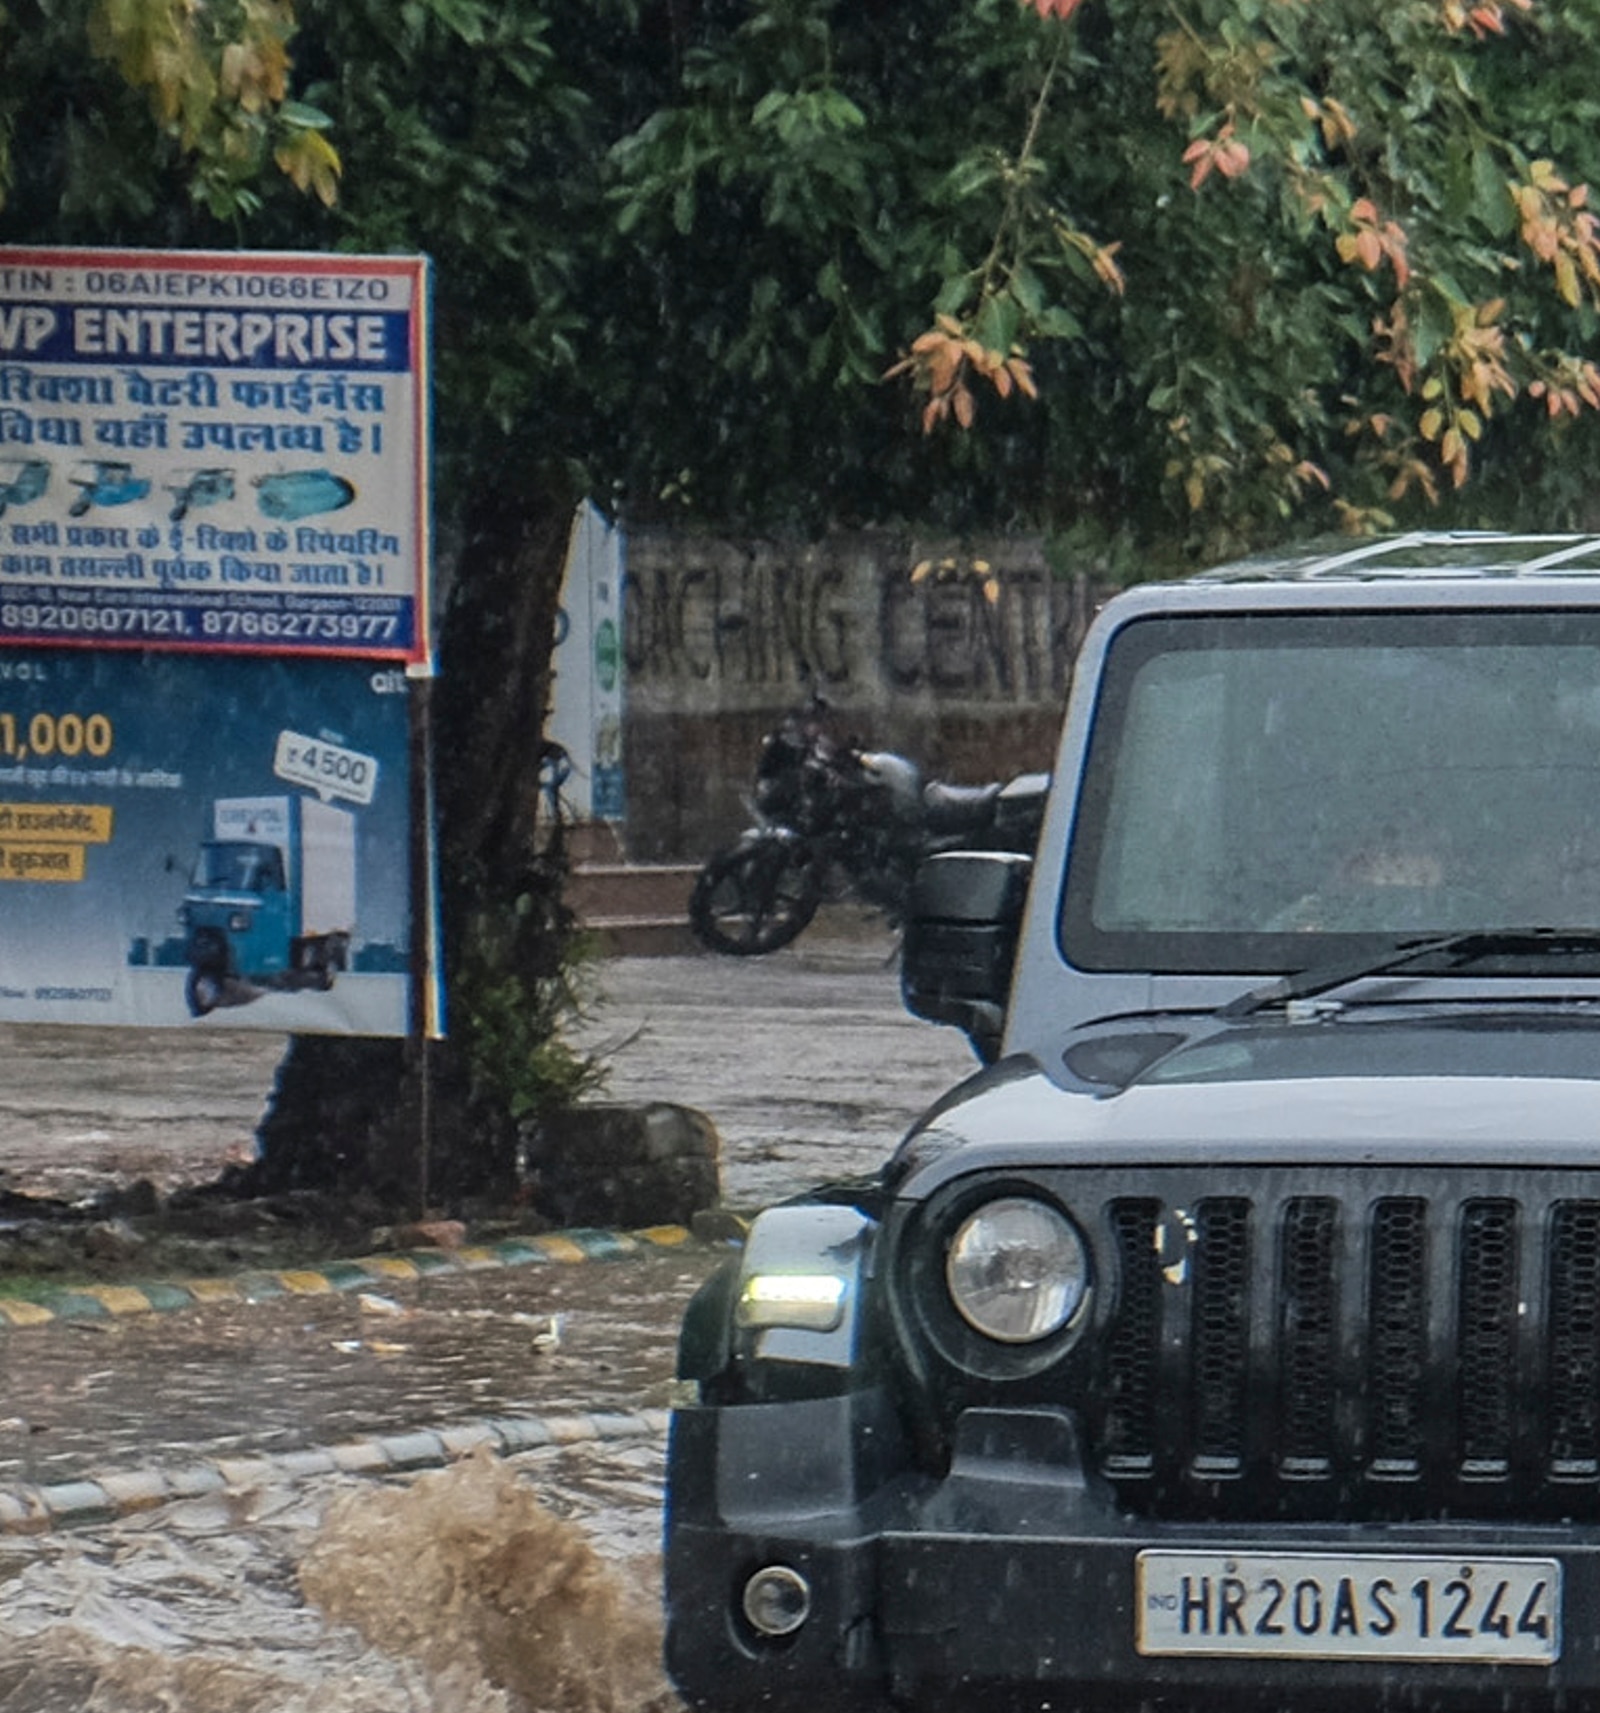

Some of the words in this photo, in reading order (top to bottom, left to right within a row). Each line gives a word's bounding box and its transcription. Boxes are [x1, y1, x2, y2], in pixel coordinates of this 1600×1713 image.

[73, 308, 387, 361] ENTERPRISE
[202, 609, 397, 640] 8766273977
[1180, 1575, 1547, 1639] HR20AS1244
